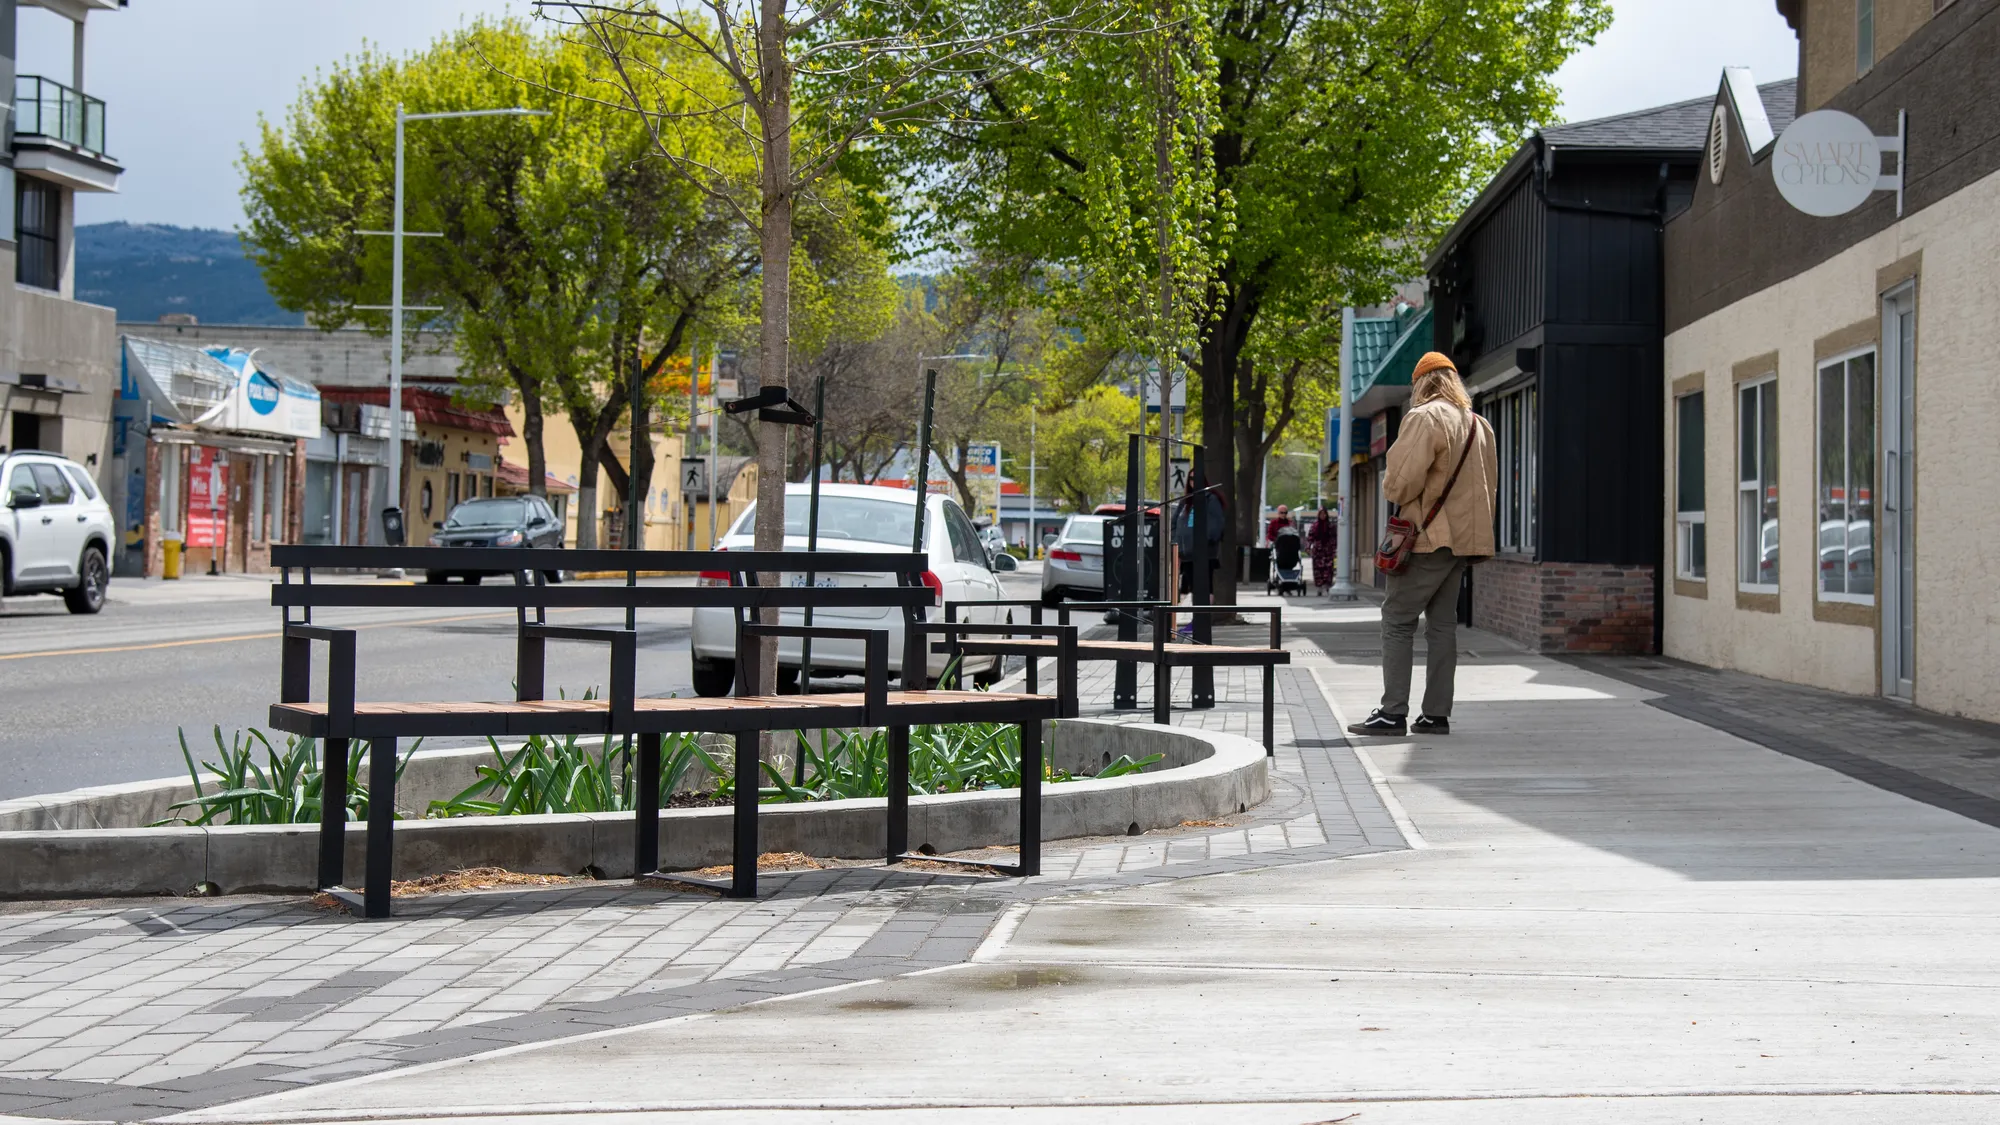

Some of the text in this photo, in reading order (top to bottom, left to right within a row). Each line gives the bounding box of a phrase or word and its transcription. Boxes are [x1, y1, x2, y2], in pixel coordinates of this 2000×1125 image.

[1783, 141, 1872, 167] SMART
[1781, 163, 1871, 186] OPTIONS
[1112, 525, 1152, 537] NW
[1111, 536, 1154, 548] ON
